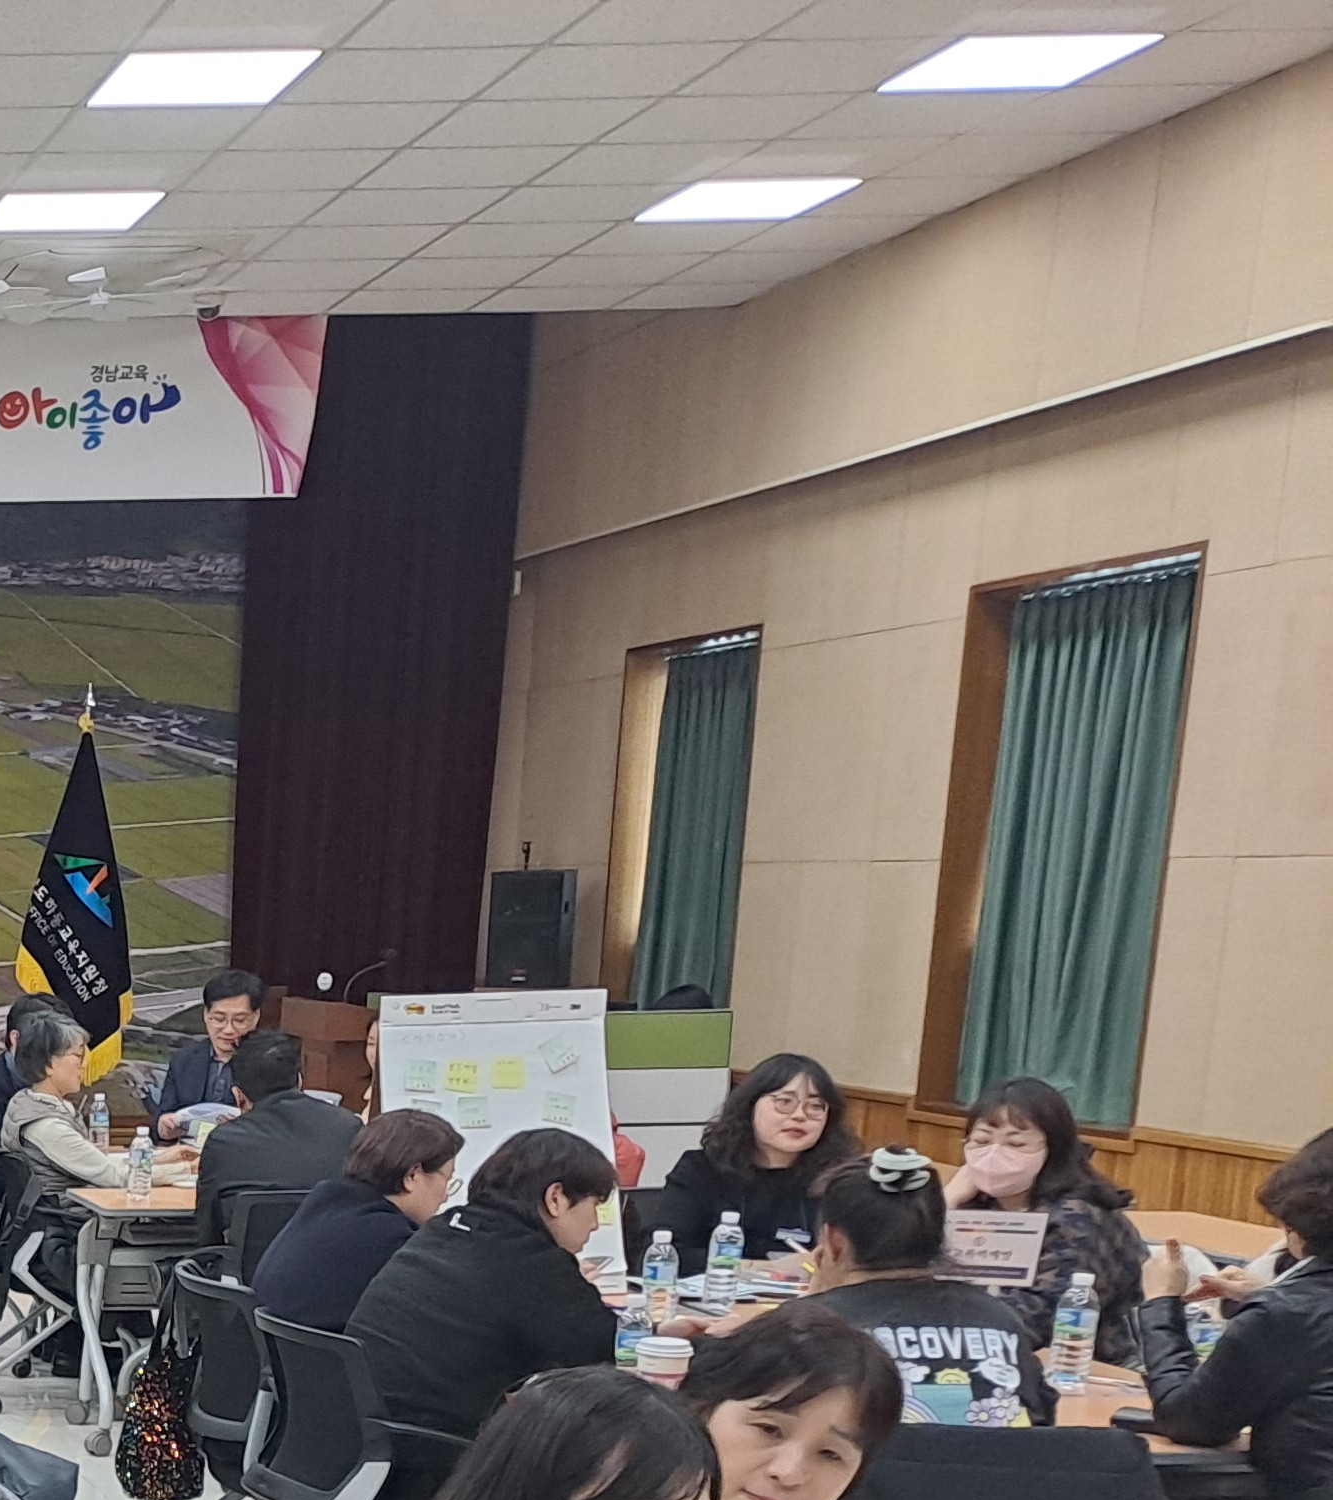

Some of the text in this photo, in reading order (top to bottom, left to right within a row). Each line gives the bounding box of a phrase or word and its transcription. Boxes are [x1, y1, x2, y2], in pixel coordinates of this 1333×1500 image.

[90, 365, 149, 383] 경남교육
[30, 905, 50, 936] FFICE
[53, 947, 92, 1003] EDUCATION
[33, 878, 109, 996] 도하동교육지원청
[873, 1325, 1019, 1365] SCOVERY
